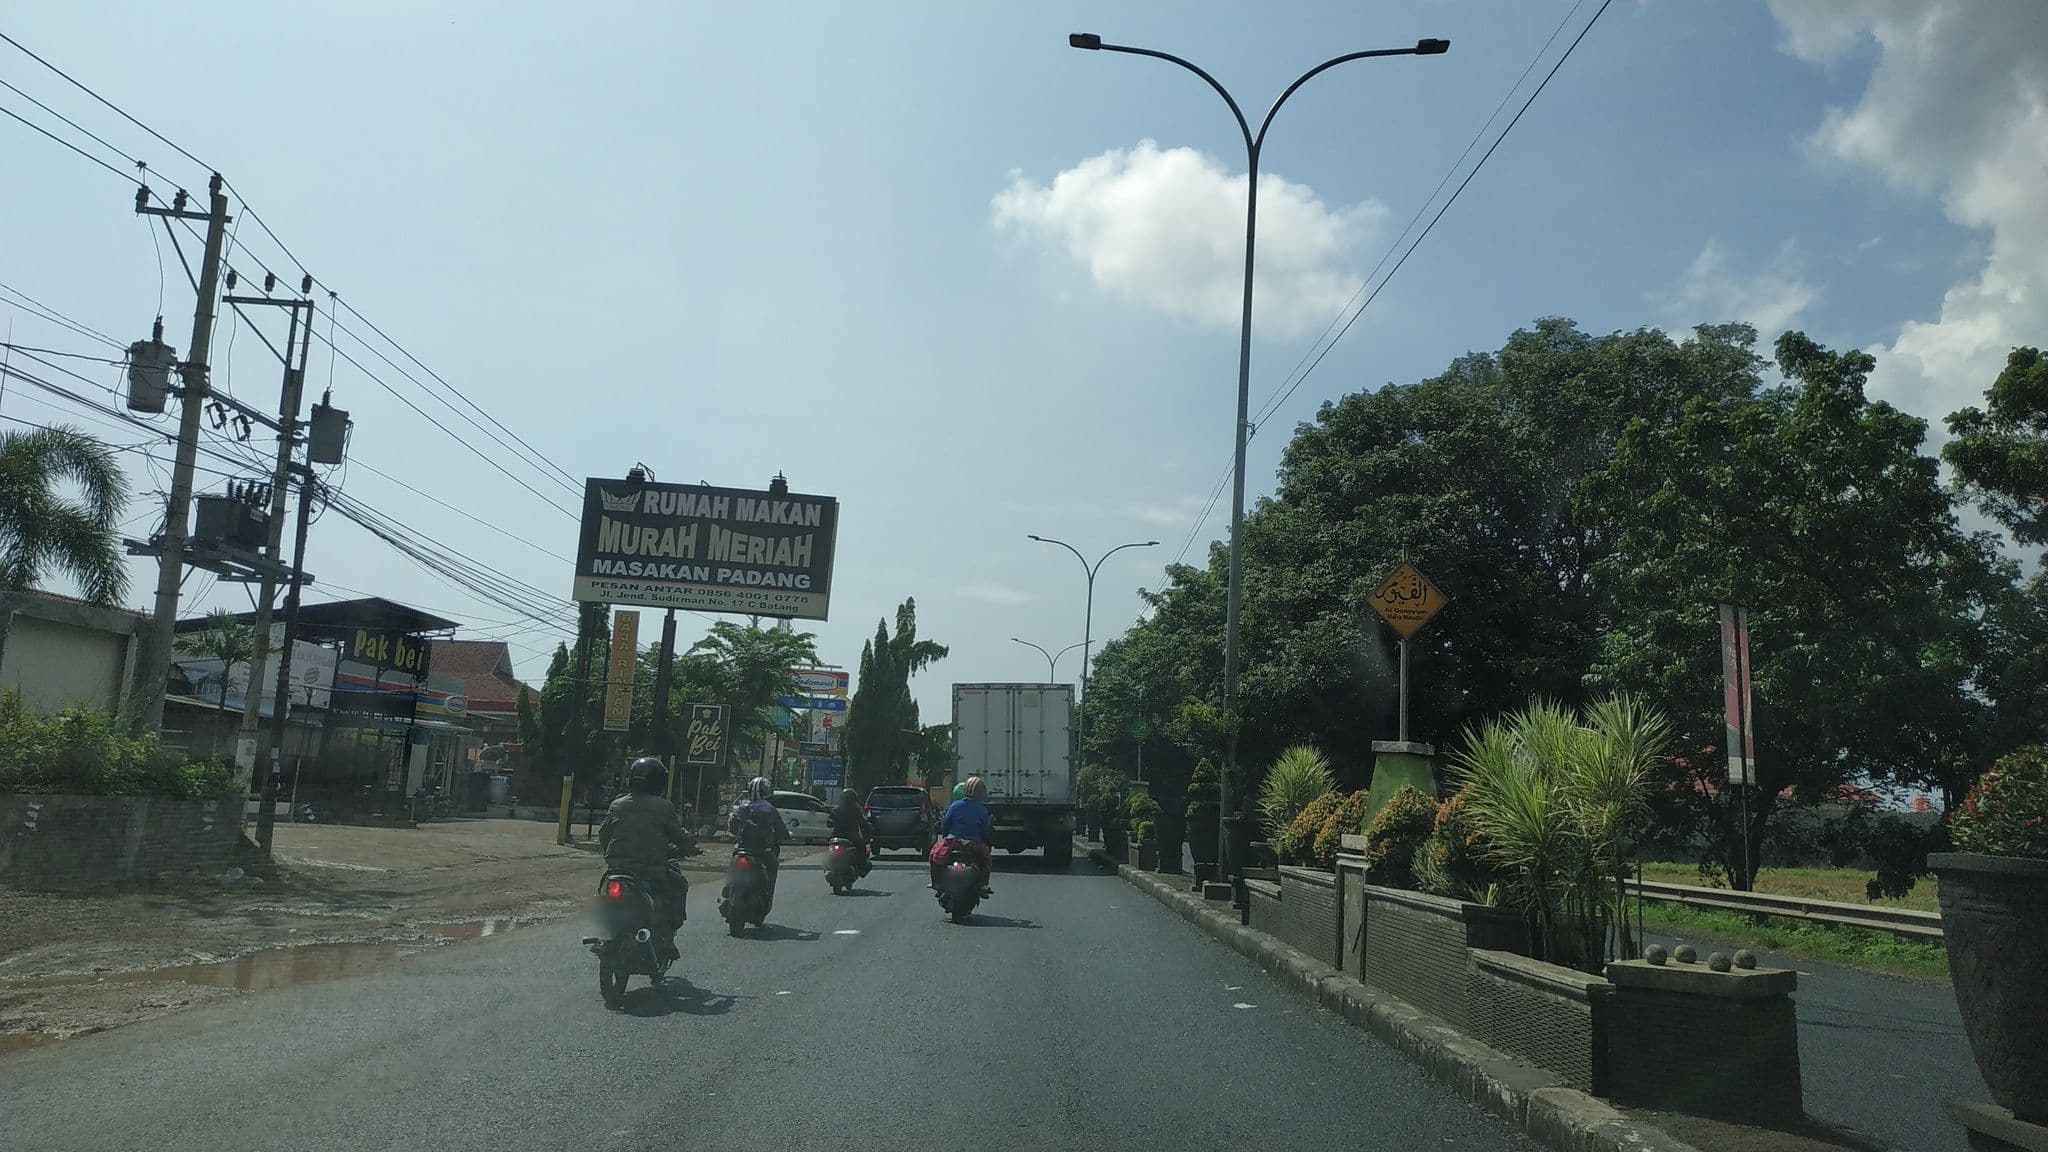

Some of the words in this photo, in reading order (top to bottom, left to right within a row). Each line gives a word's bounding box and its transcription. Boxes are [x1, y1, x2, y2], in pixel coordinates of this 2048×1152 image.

[643, 490, 729, 520] RUMAH
[735, 497, 822, 527] MAKAN
[598, 515, 698, 559] MURAH
[707, 523, 814, 568] MERIAH
[592, 559, 710, 582] MASAKAN
[717, 568, 811, 589] PADANG
[591, 581, 640, 592] PESAN
[643, 584, 693, 595] ANTAR
[697, 588, 732, 598] 0856
[736, 591, 770, 601] 4001
[775, 594, 809, 604] 0778
[600, 590, 613, 599] Jl.
[616, 591, 648, 601] Jend.
[651, 593, 705, 605] Sudirman
[709, 598, 727, 606] No.
[732, 599, 745, 607] 17
[759, 601, 799, 612] Batang
[621, 614, 632, 651] BAJA
[394, 636, 425, 670] bei
[612, 659, 629, 716] RINGAN
[687, 719, 722, 739] Pak
[689, 735, 722, 756] Bei
